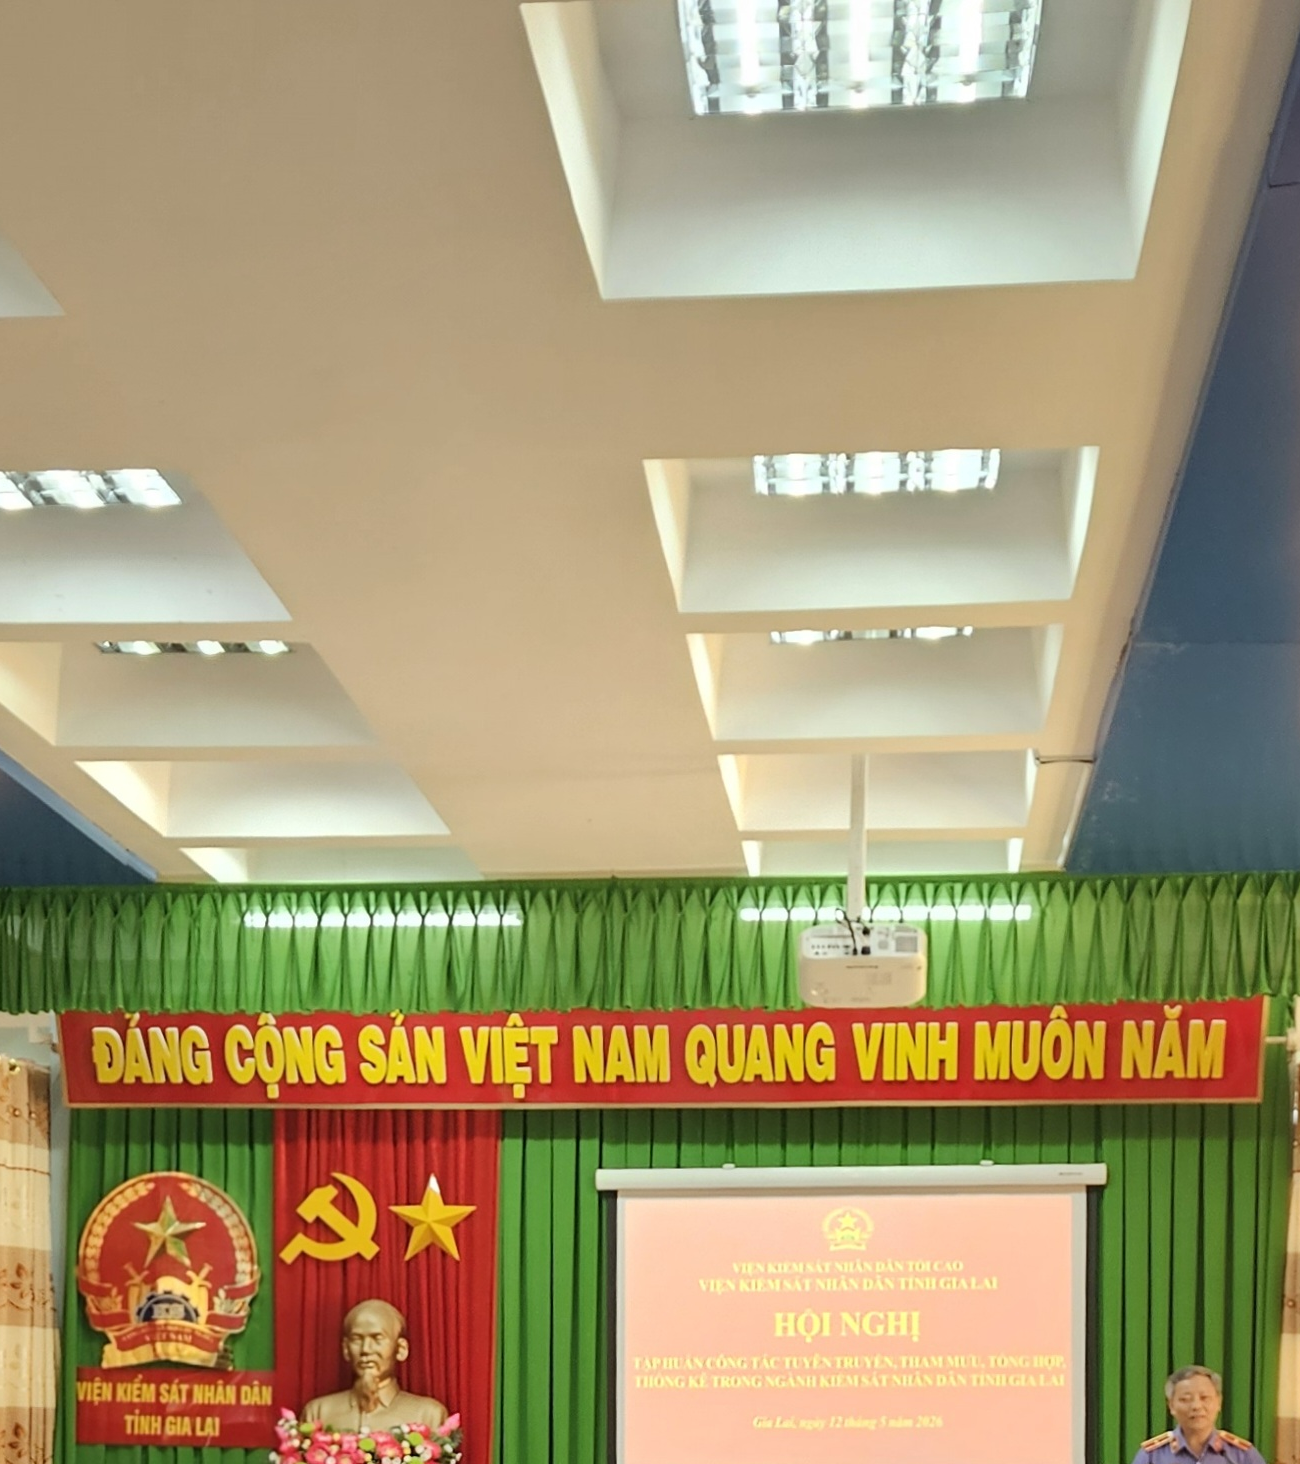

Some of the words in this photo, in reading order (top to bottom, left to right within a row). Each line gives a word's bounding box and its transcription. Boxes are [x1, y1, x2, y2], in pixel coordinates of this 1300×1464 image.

[91, 1012, 213, 1085] ĐẢNG
[224, 1011, 346, 1099] CỘNG
[358, 1009, 447, 1085] SẢN
[459, 1013, 558, 1099] VIỆT
[572, 1023, 671, 1084] NAM
[684, 1022, 836, 1088] QUANG
[852, 1020, 959, 1083] VINH
[973, 1005, 1107, 1082] MUÔN
[1120, 1005, 1226, 1080] NĂM
[732, 1261, 765, 1276] VIỆN
[767, 1260, 803, 1274] KIỂM
[805, 1258, 830, 1274] SÁT
[834, 1258, 872, 1273] NHÂN
[875, 1258, 904, 1273] DÂN
[932, 1260, 964, 1272] CAO
[699, 1277, 736, 1296] VIỆN
[739, 1276, 780, 1292] KIỂM
[782, 1275, 812, 1292] SÁT
[816, 1275, 859, 1291] NHÂN
[862, 1275, 895, 1291] DÂN
[899, 1275, 937, 1290] TỈNH
[939, 1276, 968, 1290] GIA
[970, 1276, 998, 1290] LAI
[774, 1308, 832, 1343] HỘI
[840, 1310, 921, 1343] NGHỊ
[705, 1354, 748, 1370] CÔNG
[751, 1354, 778, 1370] TÁC
[901, 1355, 944, 1369] THAM
[77, 1377, 112, 1405] VIỆN
[116, 1374, 156, 1403] KIỂM
[159, 1379, 189, 1405] SÁT
[192, 1379, 236, 1406] NHÂN
[241, 1380, 272, 1406] DÂN
[713, 1375, 762, 1388] TRONG
[765, 1372, 816, 1388] NGÀNH
[820, 1373, 858, 1388] KIỂM
[860, 1371, 887, 1388] SÁT
[892, 1371, 933, 1387] NHÂN
[936, 1371, 967, 1387] DÂN
[971, 1371, 1007, 1387] TỈNH
[1009, 1374, 1036, 1387] GIA
[1039, 1374, 1065, 1387] LAI
[124, 1410, 160, 1436] TỈNH
[164, 1417, 191, 1436] GIA
[196, 1417, 220, 1437] LAI
[752, 1416, 772, 1428] Gia
[774, 1416, 797, 1429] Lai,
